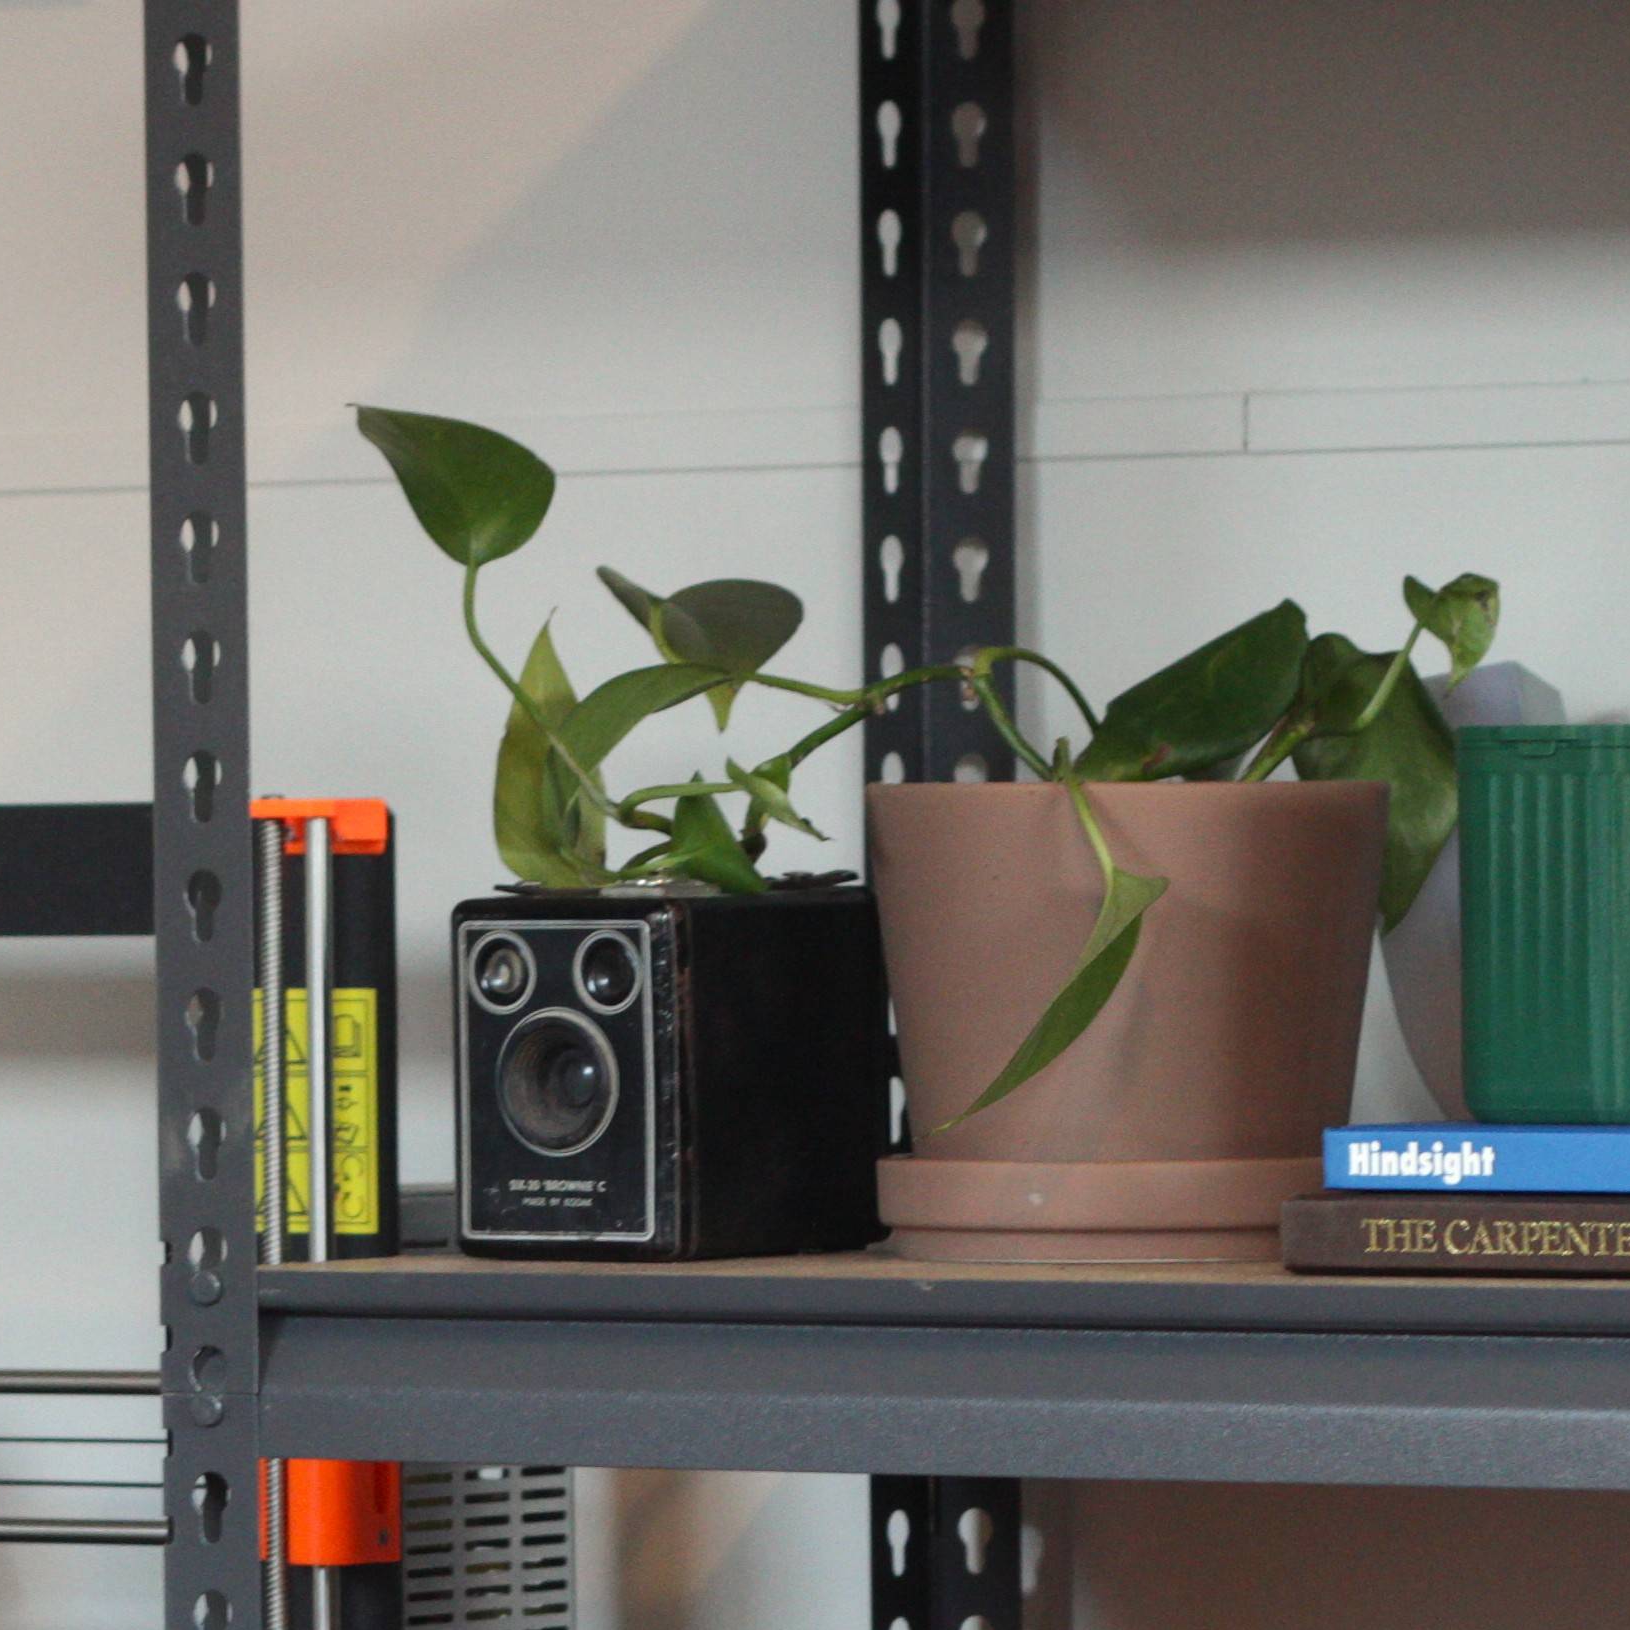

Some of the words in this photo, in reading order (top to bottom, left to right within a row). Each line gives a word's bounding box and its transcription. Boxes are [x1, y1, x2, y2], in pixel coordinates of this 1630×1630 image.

[1349, 1141, 1495, 1185] Hindsight
[596, 1180, 607, 1193] C
[1360, 1218, 1437, 1253] THE
